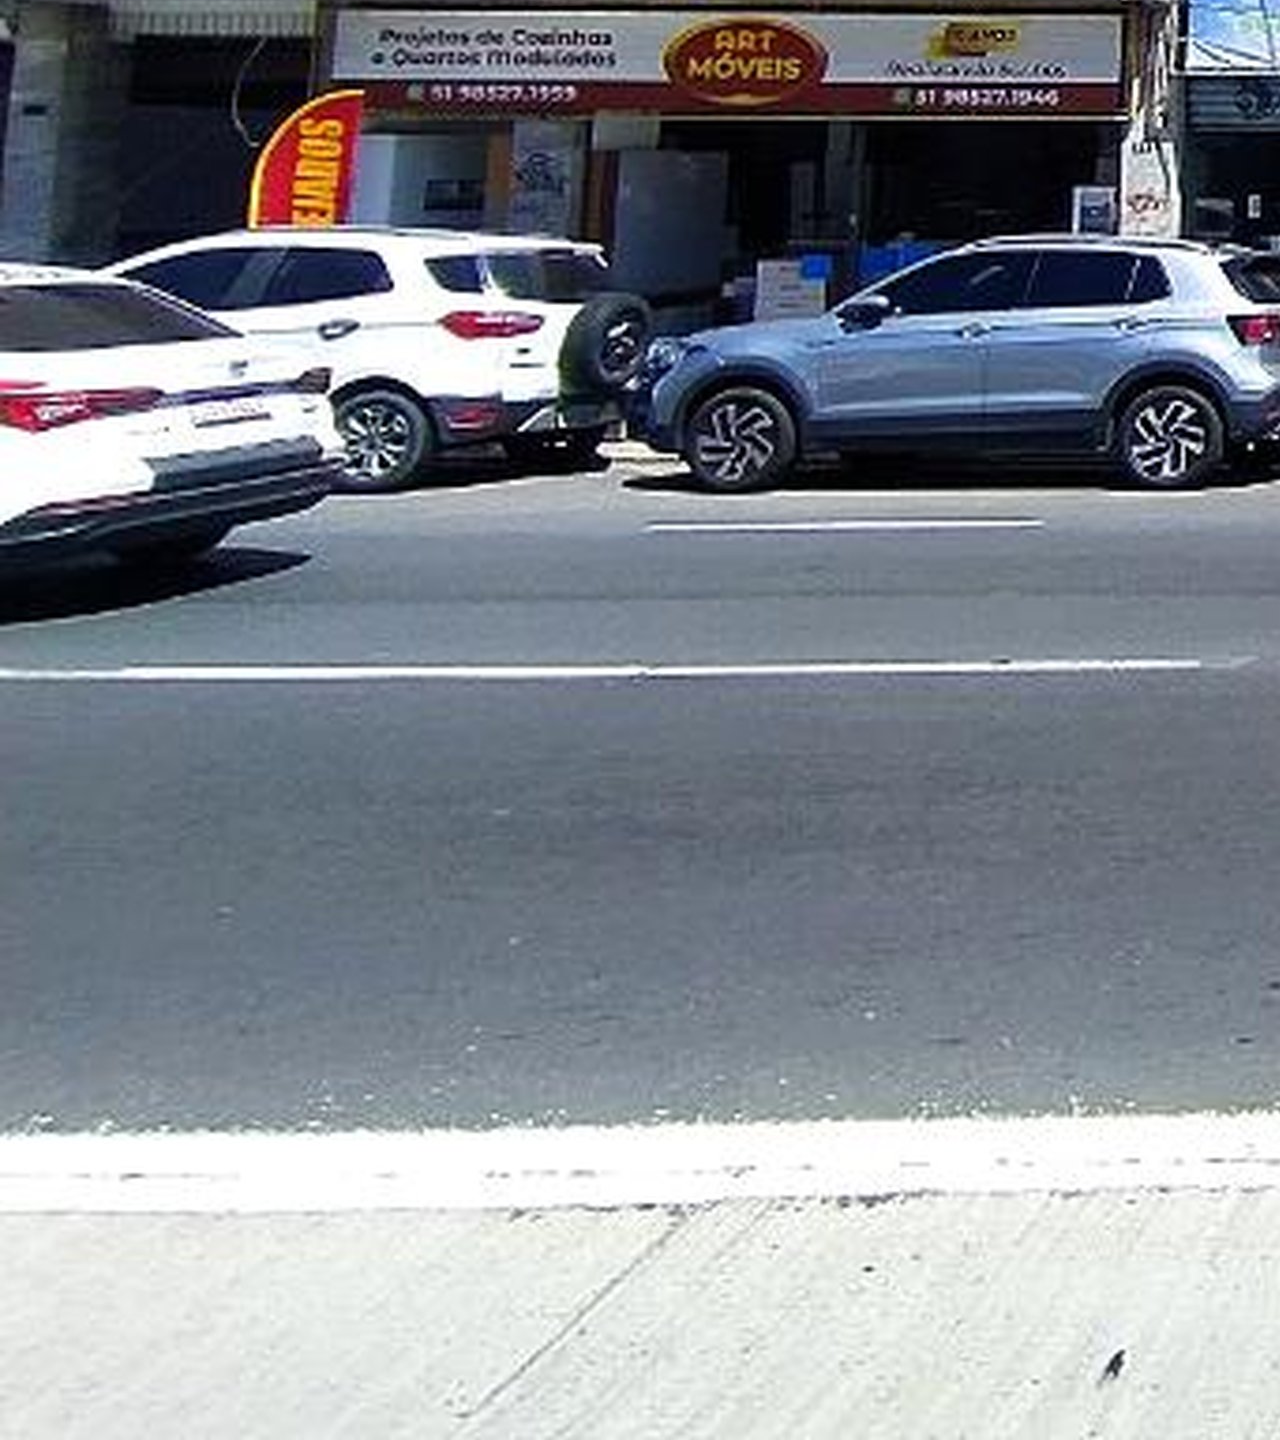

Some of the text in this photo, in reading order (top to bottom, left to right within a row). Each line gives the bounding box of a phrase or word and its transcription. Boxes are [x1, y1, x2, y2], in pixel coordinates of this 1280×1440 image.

[378, 26, 613, 48] Projetos de Cozinhas
[714, 29, 776, 52] ART
[687, 51, 802, 80] MÓVEIS
